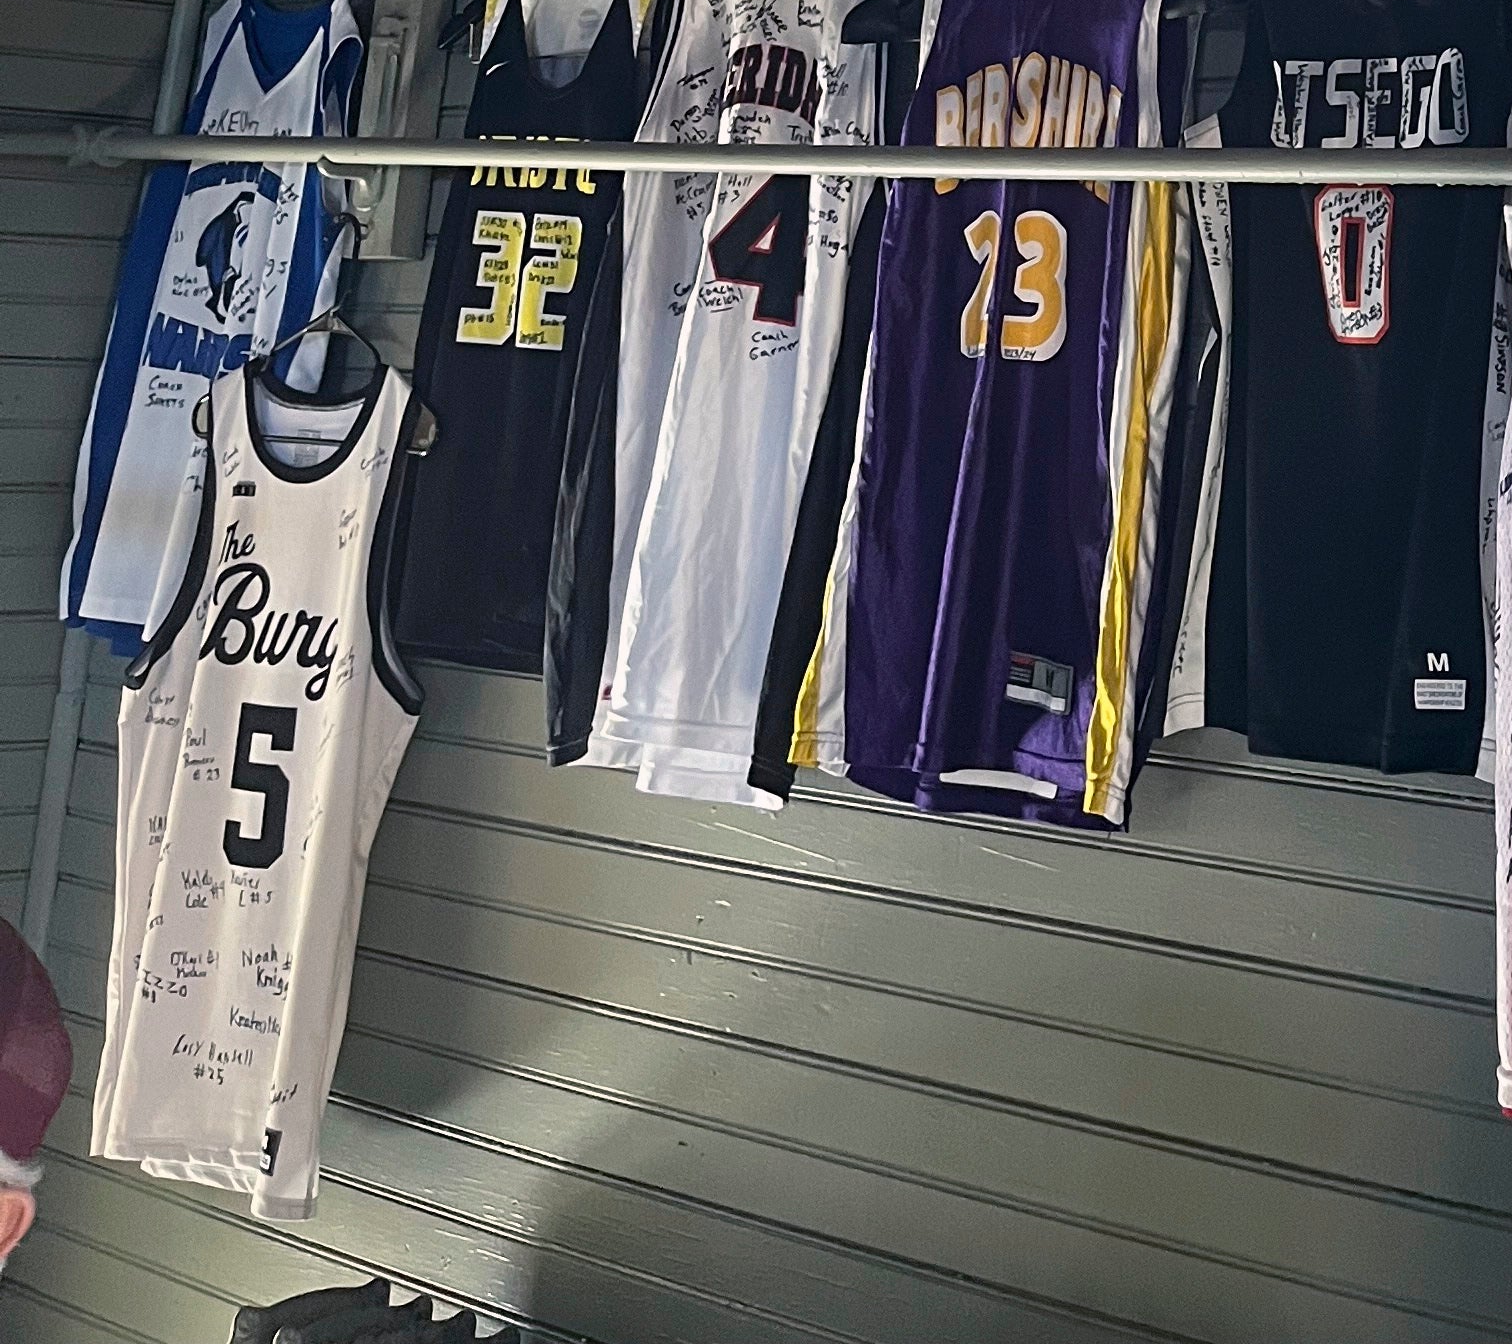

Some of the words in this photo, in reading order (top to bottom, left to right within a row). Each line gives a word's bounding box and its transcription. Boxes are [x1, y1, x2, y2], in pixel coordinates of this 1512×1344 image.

[456, 210, 582, 351] 32
[708, 174, 811, 327] 4
[961, 210, 1067, 362] 23
[1314, 183, 1394, 345] 0
[219, 520, 255, 564] The
[1427, 652, 1449, 671] M
[223, 702, 298, 869] 5
[242, 945, 279, 968] Noah
